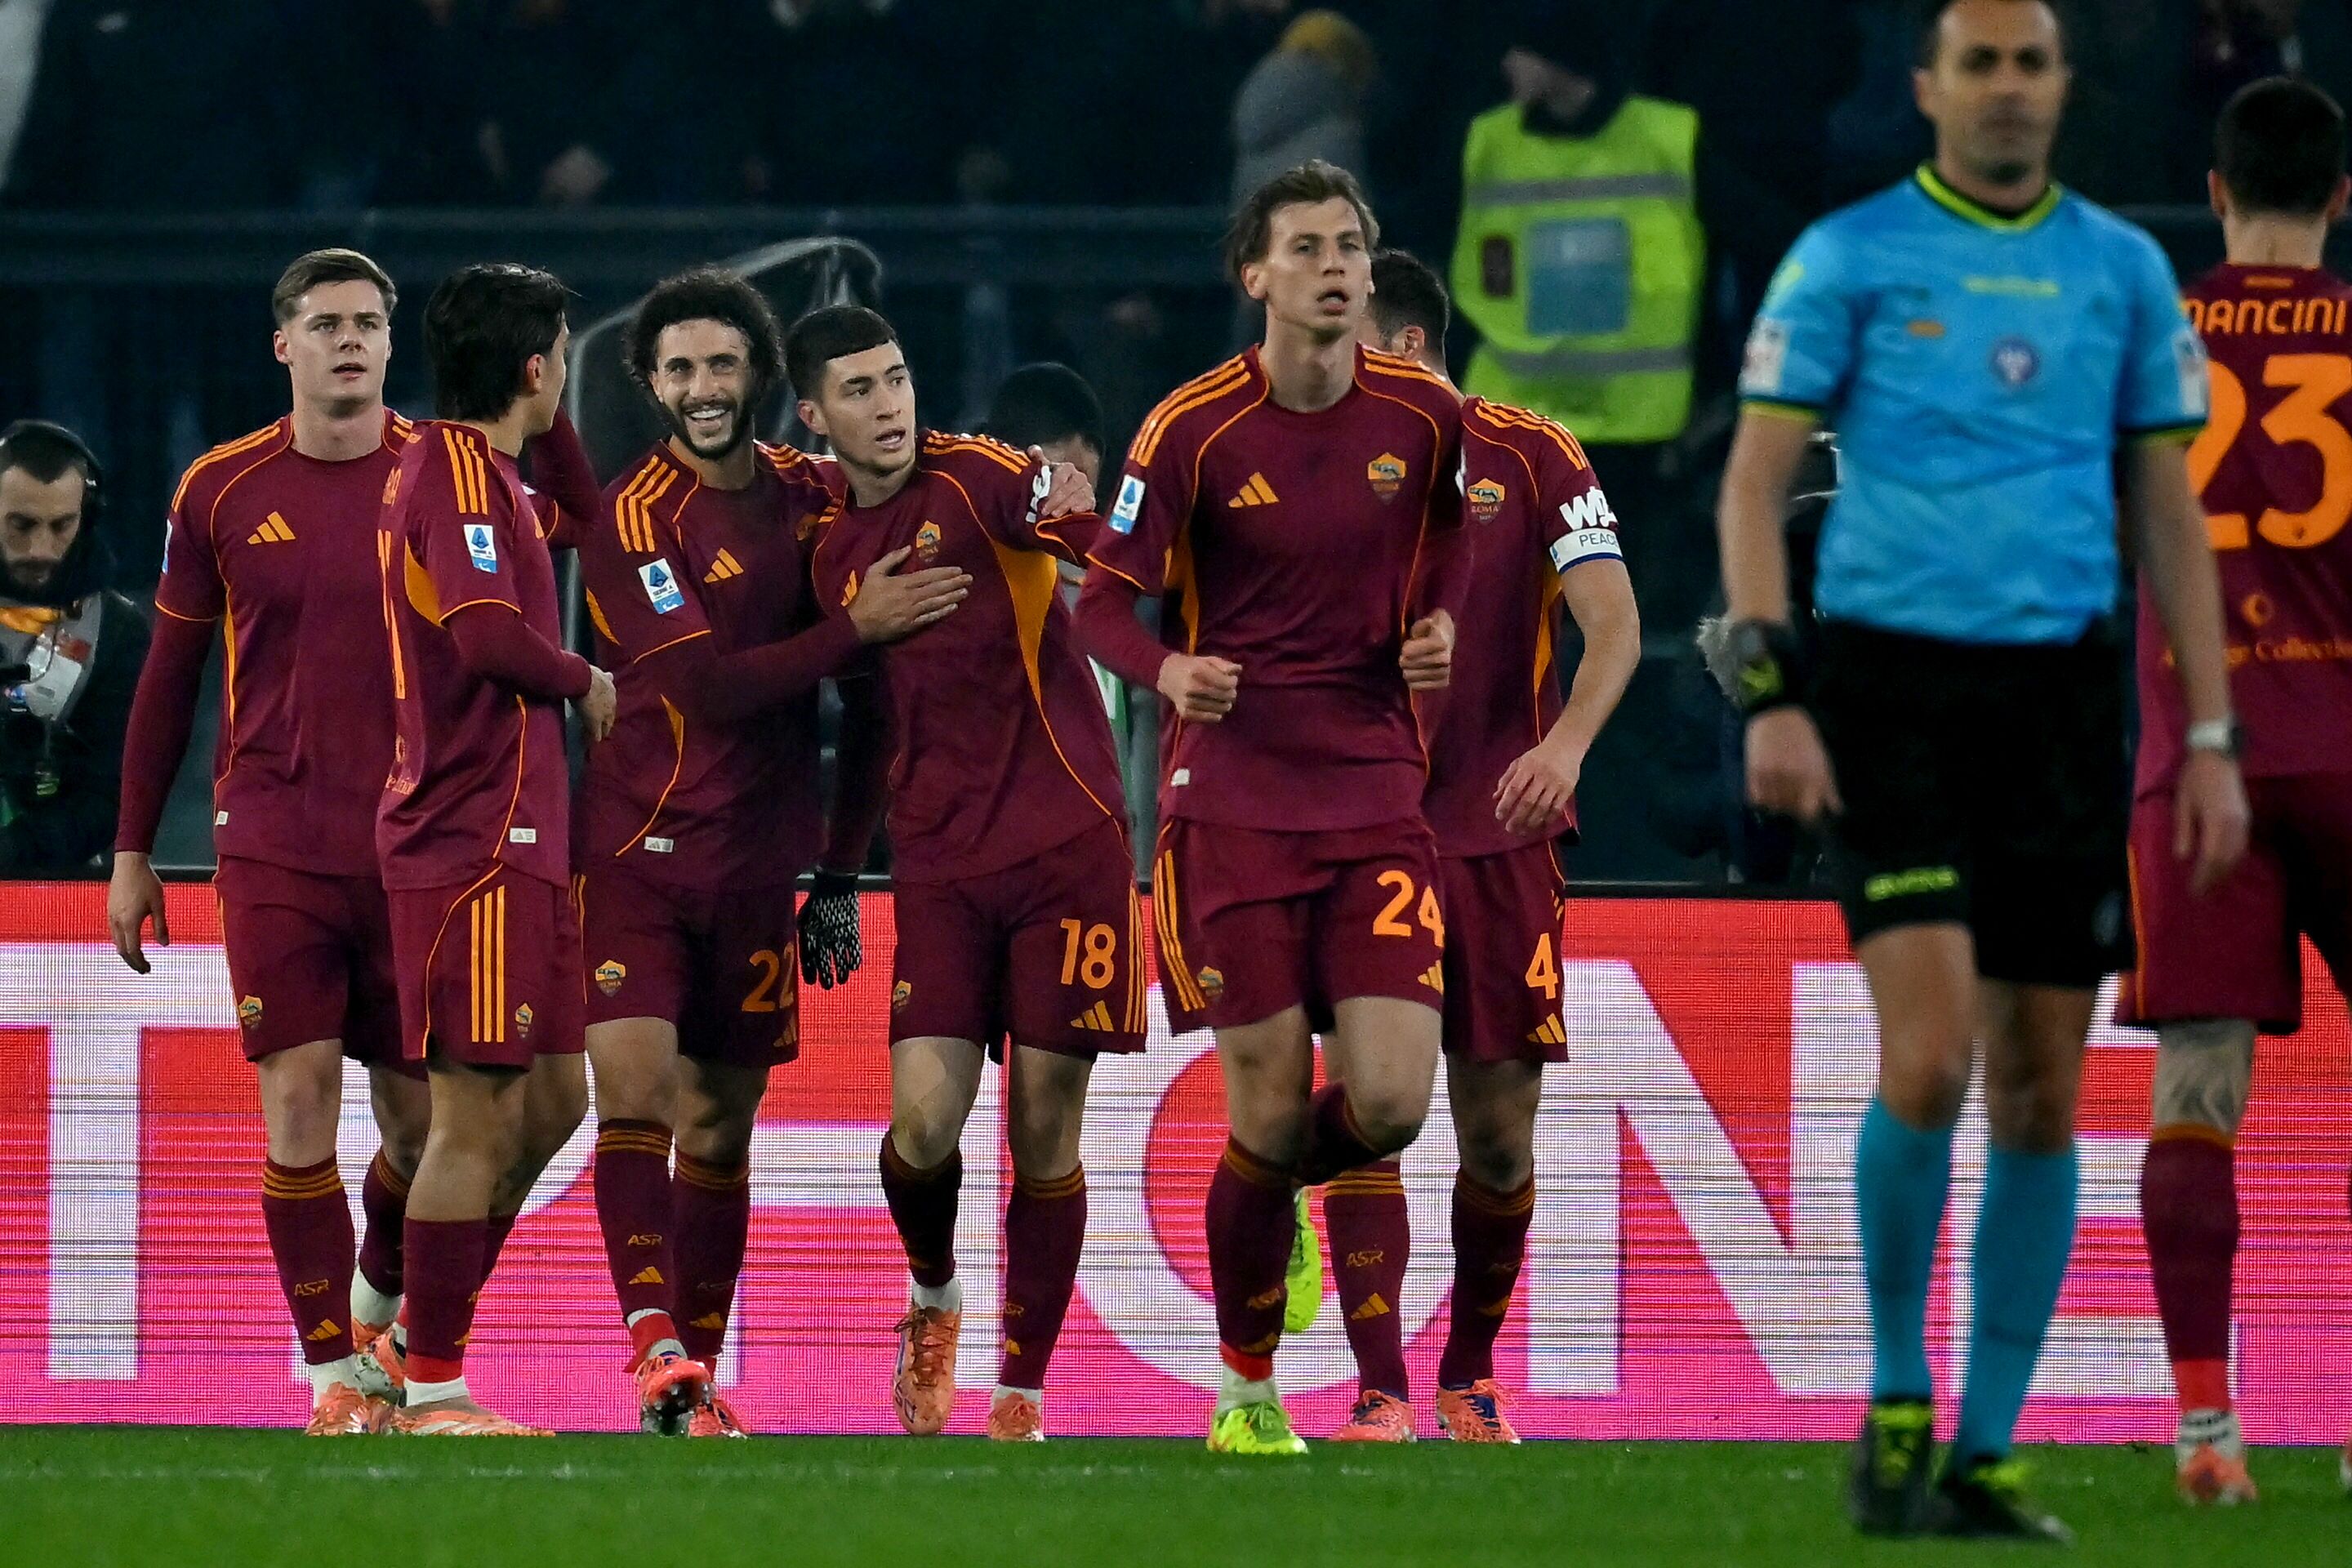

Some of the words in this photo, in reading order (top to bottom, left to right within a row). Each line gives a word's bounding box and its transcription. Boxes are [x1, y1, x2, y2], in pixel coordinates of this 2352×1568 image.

[2186, 354, 2352, 549] 23
[1373, 870, 1446, 947] 24
[1060, 918, 1116, 989] 18
[1526, 933, 1559, 1000] 4
[628, 1234, 662, 1245] ASR
[1346, 1250, 1383, 1267] ASR
[294, 1279, 330, 1296] ASR
[1003, 1302, 1025, 1318] SR
